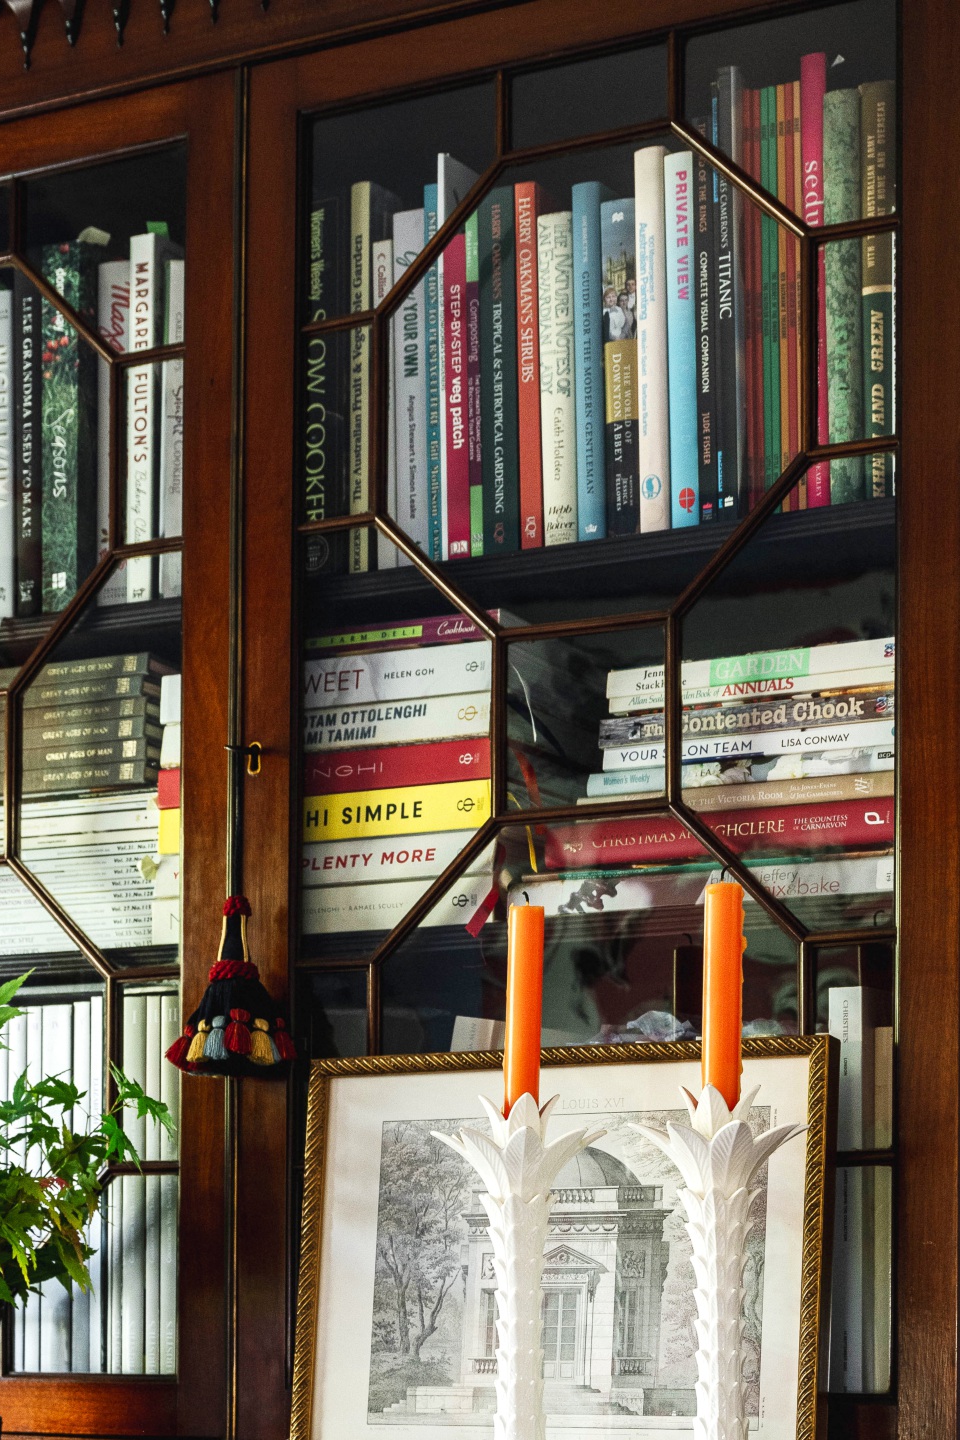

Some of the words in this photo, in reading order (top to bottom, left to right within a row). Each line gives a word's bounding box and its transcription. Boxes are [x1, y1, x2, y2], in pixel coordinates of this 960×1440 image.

[699, 170, 707, 187] OF
[699, 189, 707, 202] THE
[519, 197, 532, 243] HARRY
[676, 170, 689, 247] PRIVATE
[699, 205, 707, 233] RINGS
[720, 194, 729, 248] CAMERON'S
[353, 234, 363, 288] Garden
[639, 223, 649, 276] Australian
[520, 249, 533, 324] OAKMAN'S
[555, 253, 573, 318] NATURE
[677, 255, 689, 300] VIEW
[700, 252, 708, 299] COMPLETE
[719, 251, 732, 319] TITANIC
[22, 297, 32, 334] LIKE
[639, 277, 649, 321] Painting
[700, 300, 709, 332] VISUAL
[404, 303, 418, 342] YOUR
[451, 284, 461, 373] STEP-BY-STEP
[469, 299, 480, 363] Composting
[493, 302, 503, 356] TROPICAL
[583, 313, 591, 335] FOR
[520, 328, 533, 383] SHRUBS
[555, 321, 573, 376] NOTES
[871, 309, 885, 373] GREEN
[22, 338, 32, 419] GRANDMA
[404, 344, 418, 379] OWN
[493, 358, 503, 370] &
[624, 365, 632, 386] THE
[701, 335, 710, 393] COMPANION
[353, 377, 363, 411] Fruit
[449, 376, 460, 404] veg
[555, 378, 573, 398] OF
[612, 353, 623, 418] DOWNTON
[134, 373, 149, 463] FULTON'S
[493, 371, 503, 446] SUBTROPICAL
[553, 407, 564, 437] Edith
[624, 390, 632, 428] WORLD
[871, 384, 885, 425] AND
[408, 423, 416, 457] Stewart
[450, 407, 464, 449] patch
[624, 431, 632, 444] OF
[702, 412, 710, 433] JUDE
[22, 422, 32, 464] USED
[353, 414, 363, 475] Australian
[431, 441, 440, 460] Bill
[586, 422, 594, 494] GENTLEMAN
[612, 423, 623, 462] ABBEY
[702, 436, 710, 465] FISHER
[22, 465, 32, 489] TO
[553, 440, 564, 481] Holden
[353, 477, 363, 502] The
[408, 465, 416, 492] Simon
[431, 466, 440, 517] Mollison
[493, 447, 503, 513] GARDENING
[22, 492, 32, 538] MAKE
[408, 494, 416, 519] Leake
[525, 516, 536, 538] UQP
[384, 670, 412, 680] HELEN
[415, 668, 435, 677] GOH
[715, 652, 806, 680] GARDEN
[722, 677, 795, 697] ANNUALS
[341, 704, 428, 725] OTTOLENGHI
[792, 697, 865, 722] Chook
[327, 726, 377, 742] TAMIMI
[620, 750, 658, 762] YOUR
[714, 740, 753, 754] TEAM
[781, 738, 802, 748] LISA
[804, 733, 850, 745] CONWAY
[341, 801, 423, 825] SIMPLE
[757, 791, 783, 800] ROOM
[794, 817, 808, 825] THE
[809, 814, 848, 824] COUNTESS
[800, 821, 847, 831] CARNARVON
[380, 848, 437, 865] MORE
[378, 902, 404, 910] SCULLY
